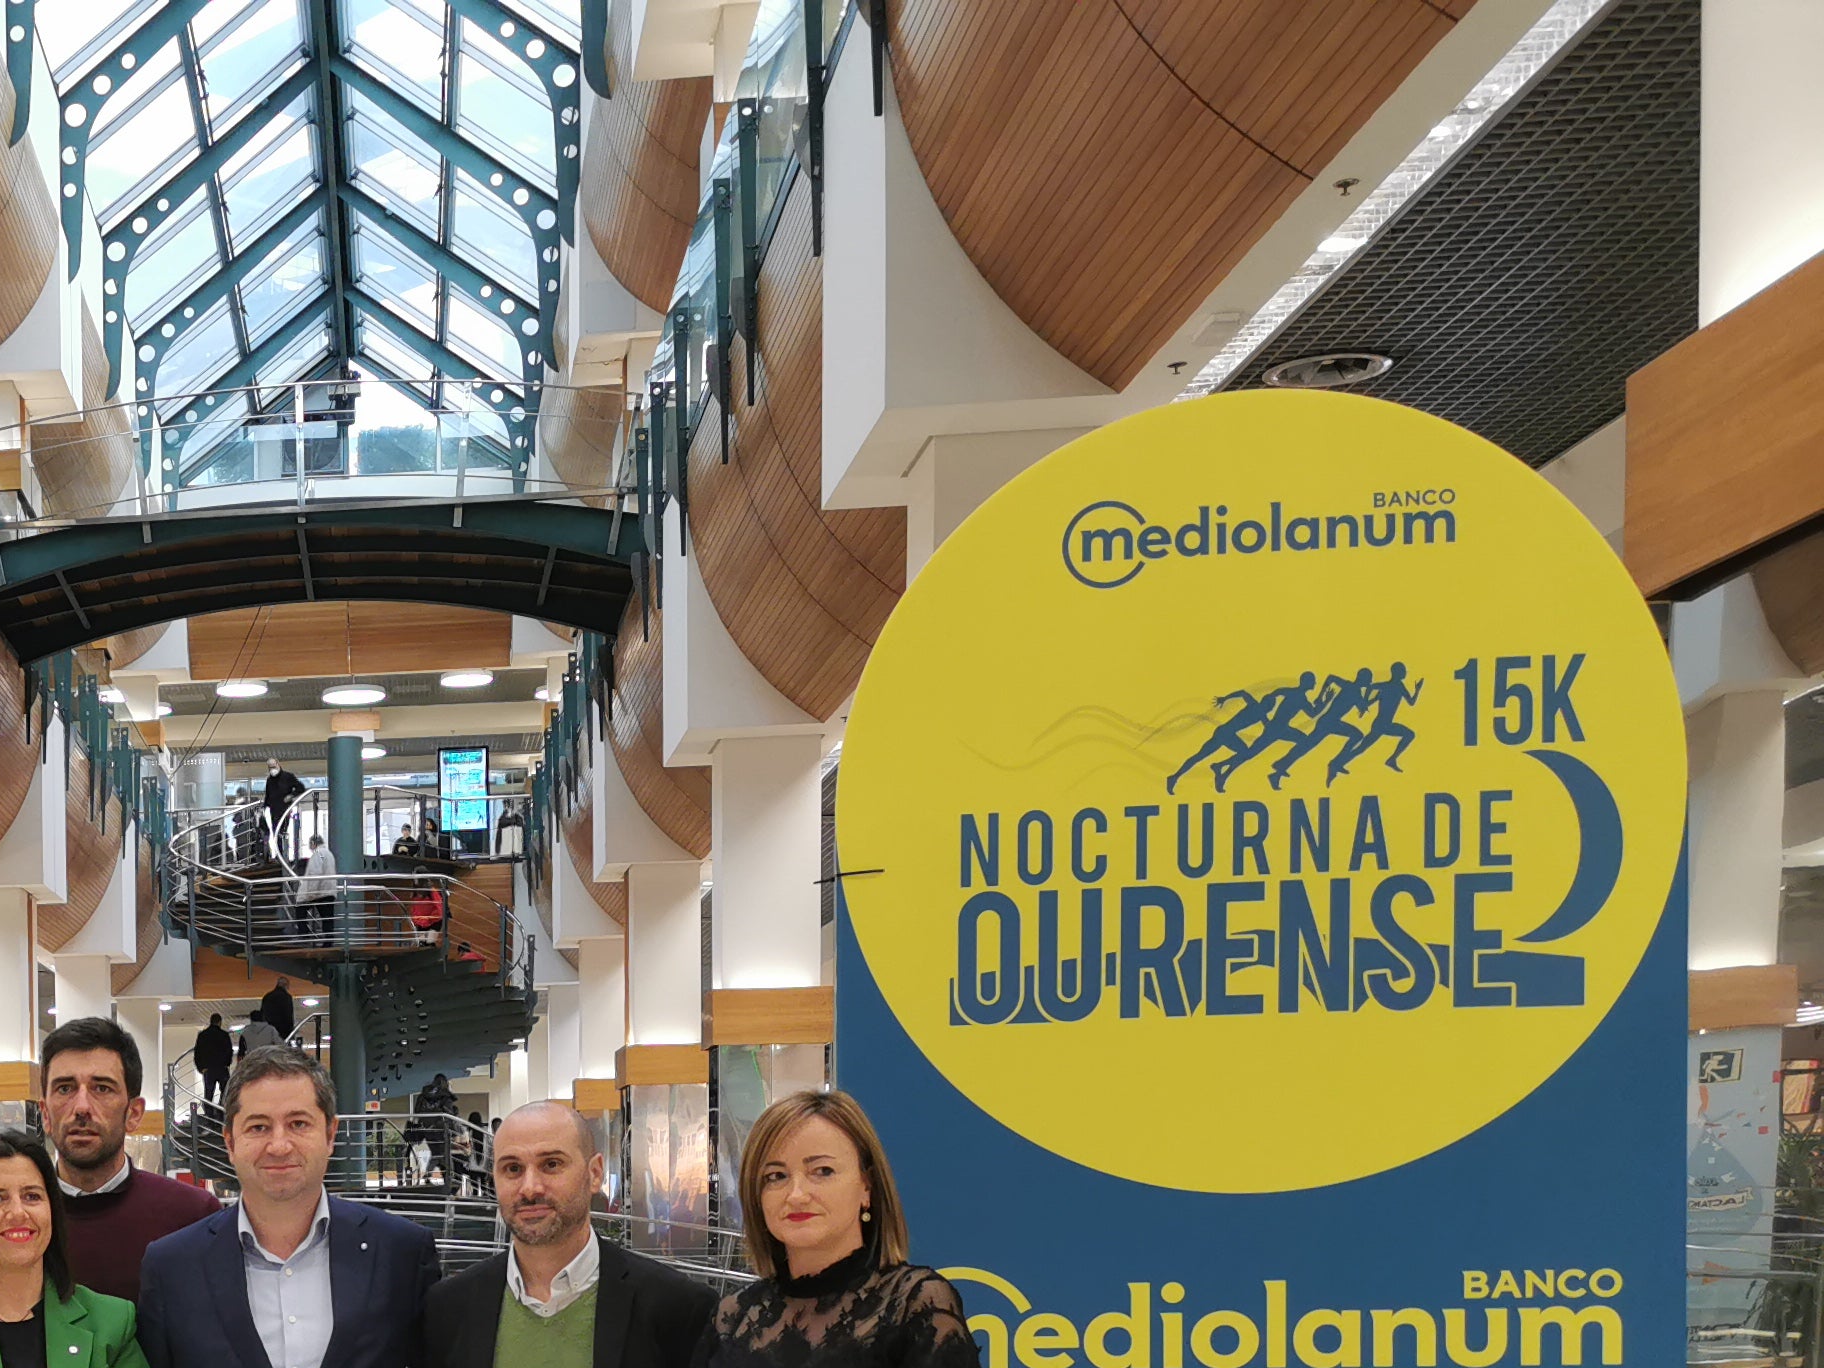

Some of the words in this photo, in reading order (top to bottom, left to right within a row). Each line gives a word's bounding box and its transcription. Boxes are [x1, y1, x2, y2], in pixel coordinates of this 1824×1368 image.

[1079, 502, 1457, 565] mediolanum
[1373, 489, 1456, 508] BANCO
[1454, 655, 1587, 747] 15K
[959, 796, 1388, 888] NOCTURNA
[1424, 789, 1514, 869] DE
[953, 873, 1518, 1026] OURENSE
[1465, 1269, 1623, 1298] BANCO
